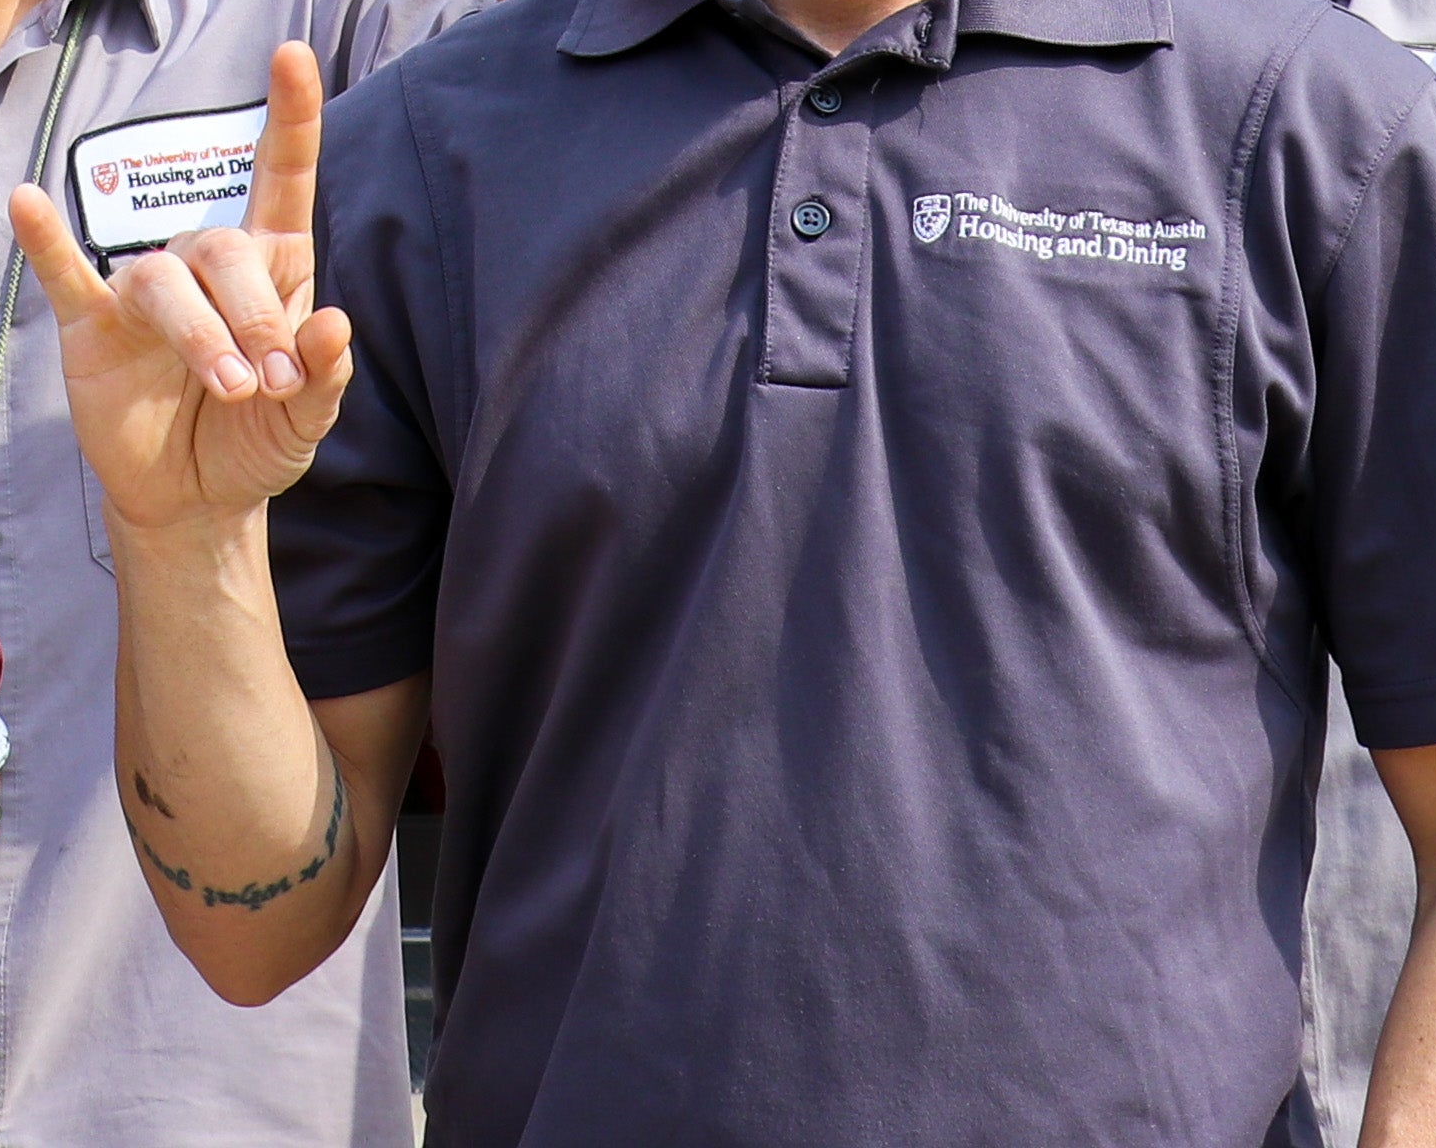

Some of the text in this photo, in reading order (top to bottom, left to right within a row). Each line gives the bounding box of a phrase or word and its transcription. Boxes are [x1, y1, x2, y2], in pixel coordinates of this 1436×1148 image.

[121, 157, 143, 170] The
[144, 150, 198, 168] University
[200, 148, 210, 160] of
[212, 146, 242, 159] Texas
[244, 142, 255, 153] at
[127, 166, 195, 189] Housing
[196, 162, 226, 180] and
[131, 183, 248, 211] Maintenance
[955, 191, 1206, 239] The University of Texas at Austin
[958, 214, 1188, 271] Housing and Dining
